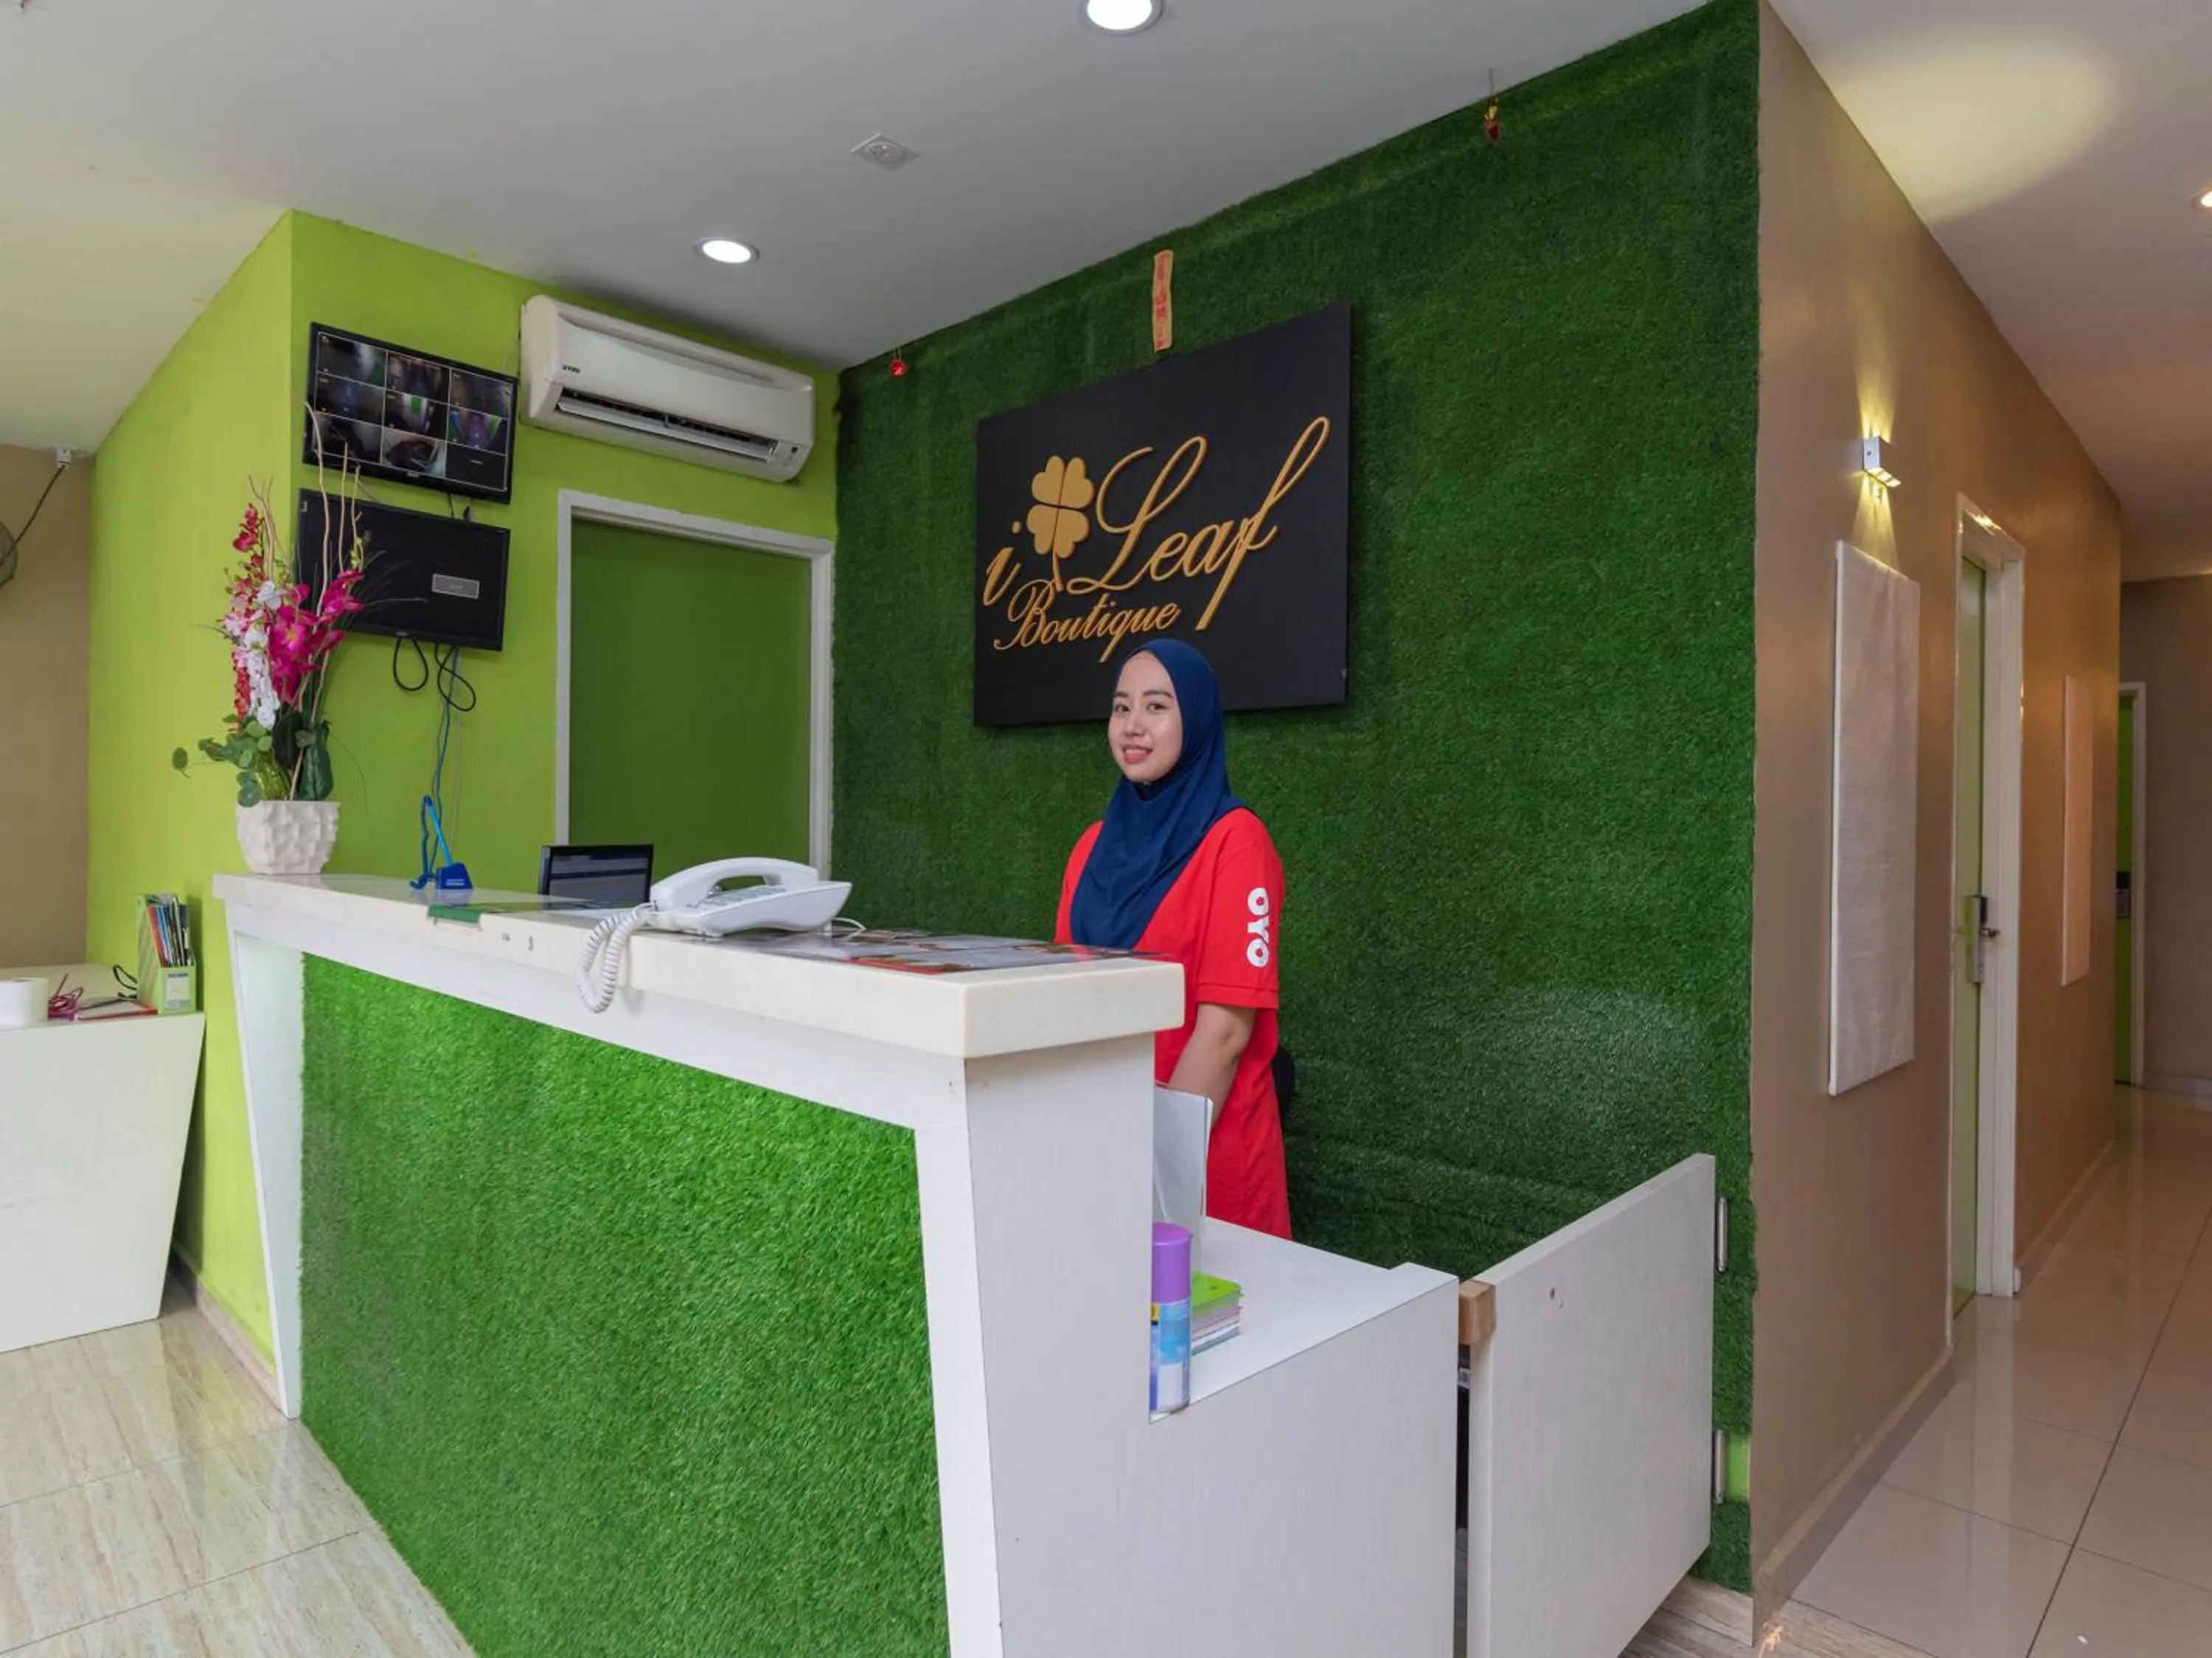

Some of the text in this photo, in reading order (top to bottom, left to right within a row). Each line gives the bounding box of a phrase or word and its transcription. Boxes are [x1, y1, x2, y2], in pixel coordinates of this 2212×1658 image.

[1066, 415, 1330, 631] Leaf
[993, 579, 1181, 662] Boutique
[1247, 887, 1270, 968] OYO
